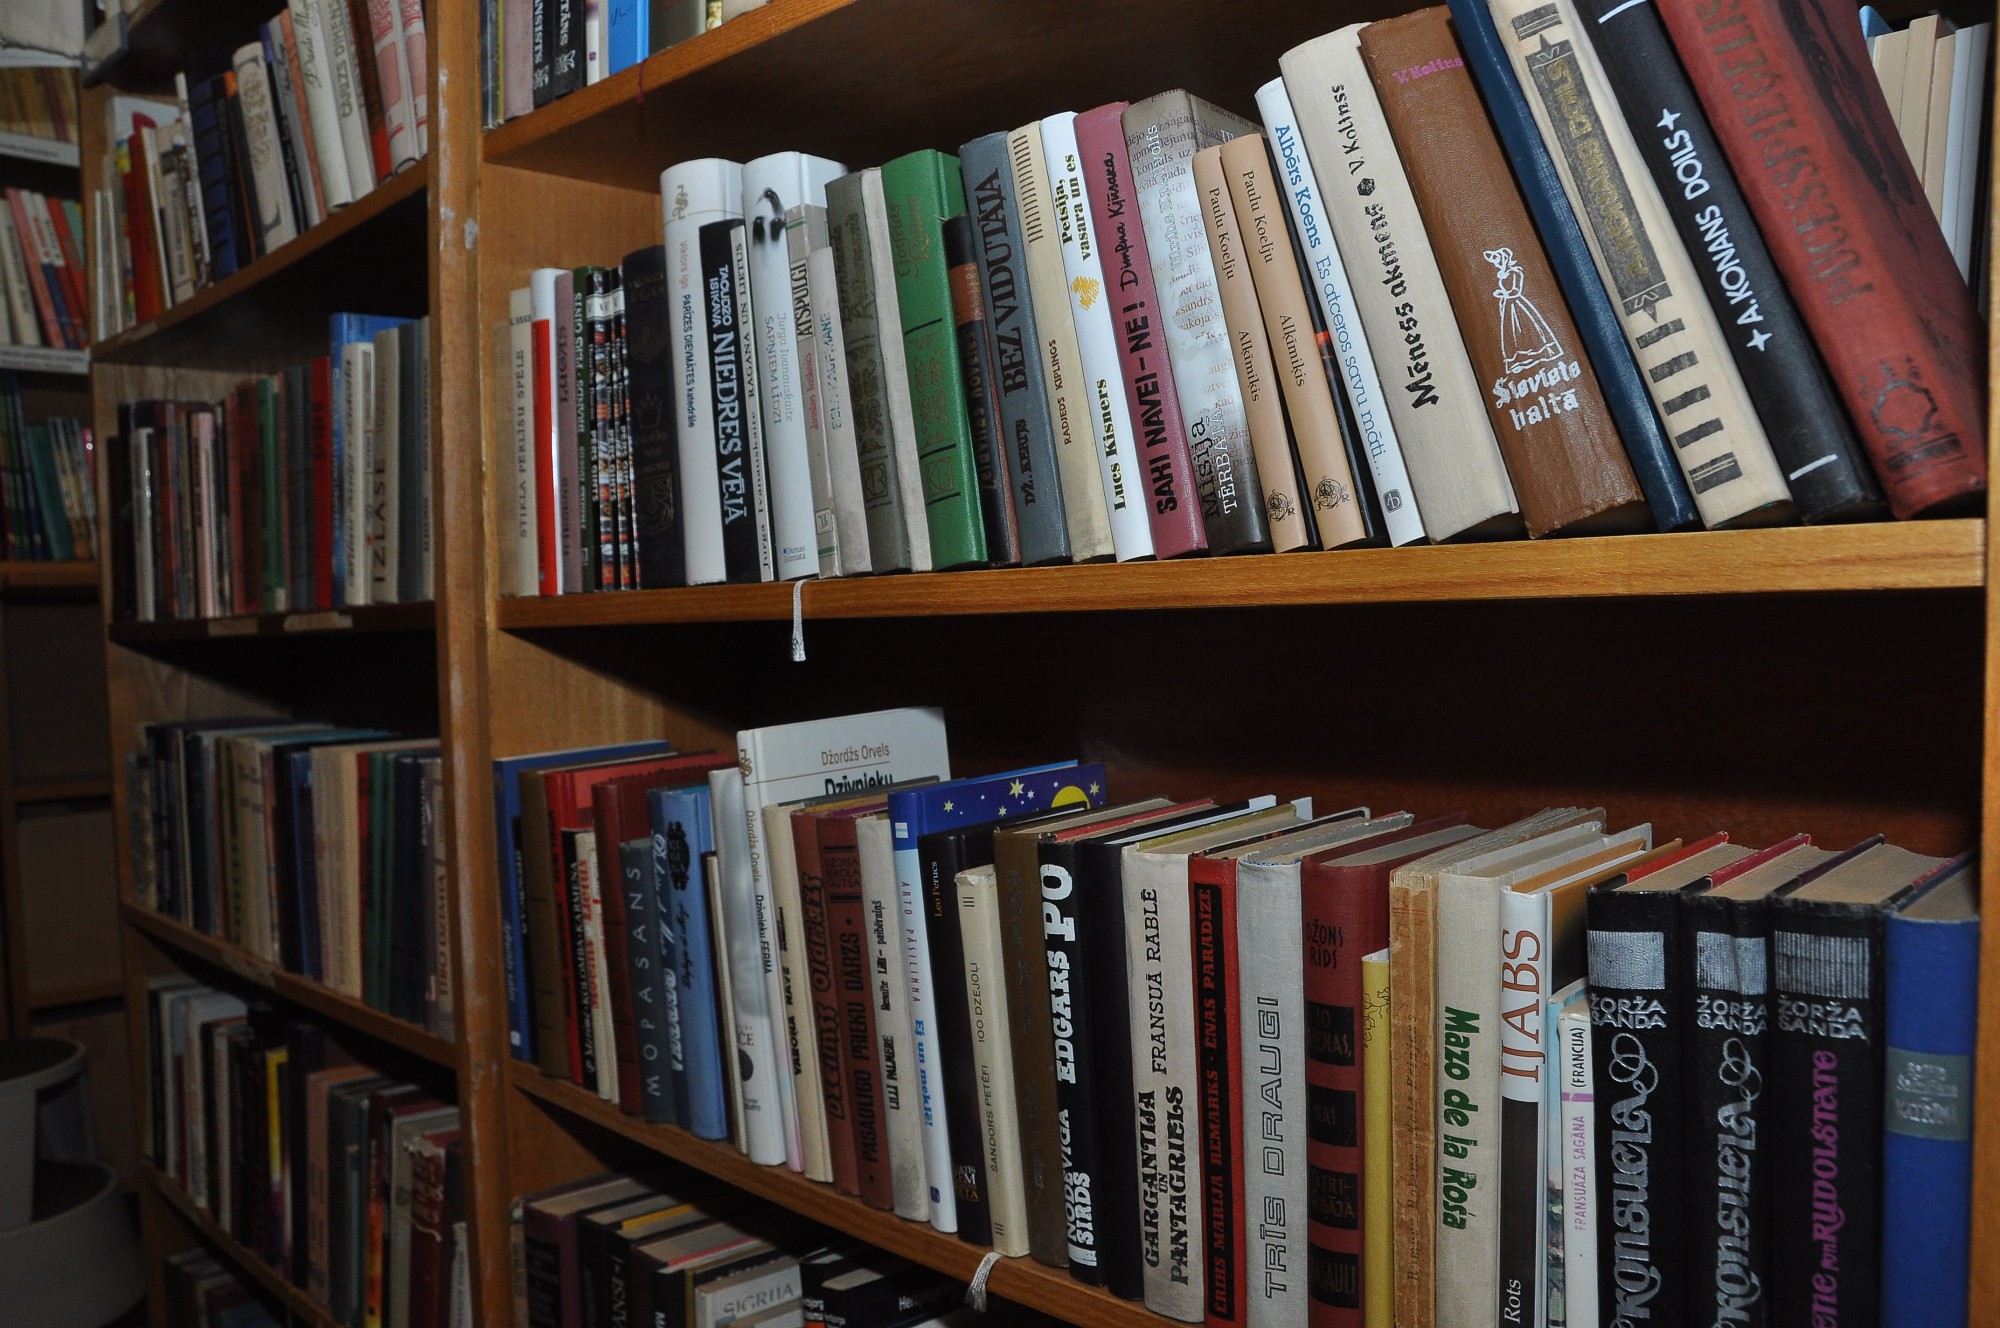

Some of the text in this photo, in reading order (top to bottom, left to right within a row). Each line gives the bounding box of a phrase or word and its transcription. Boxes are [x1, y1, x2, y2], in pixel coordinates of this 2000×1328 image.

[1275, 124, 1302, 187] Albērs
[1663, 128, 1711, 201] DOILS
[1063, 153, 1092, 262] vasara un es
[1209, 187, 1224, 229] Paulu
[1218, 232, 1236, 280] Koelju
[1243, 169, 1259, 212] Paulu
[1254, 215, 1274, 264] Koelju
[1294, 186, 1322, 249] Koens
[734, 243, 747, 296] LIETUS
[1316, 255, 1332, 280] Es
[738, 302, 750, 326] UN
[1323, 282, 1352, 353] atceros
[742, 332, 756, 398] RAGANA
[996, 326, 1029, 398] BEZ
[1345, 356, 1367, 408] savu
[1394, 302, 1440, 410] Mēness
[712, 331, 743, 455] NIEDRES
[770, 385, 783, 426] LĪDZI
[1048, 338, 1073, 446] RADJEDS KIPLINGS
[1096, 378, 1127, 513] Lucs Kisners
[860, 742, 891, 759] Orvels
[901, 880, 913, 918] ARTO
[931, 861, 943, 918] Leo Perucs
[1039, 863, 1077, 1085] EDGARS PO
[1140, 888, 1168, 1076] FRANSUĀ RABLĒ
[1591, 993, 1667, 1015] ŽORŽA
[847, 1001, 870, 1061] PRIEKU
[913, 1019, 925, 1039] Ej
[1591, 1012, 1668, 1030] SANDA
[1696, 994, 1768, 1019] ŽORŽA
[1696, 1014, 1768, 1036] SANDA
[1777, 994, 1864, 1024] ŽORŽA
[1777, 1015, 1868, 1041] SANDA
[917, 1042, 927, 1061] un
[1570, 1026, 1587, 1089] (FRANCIJA)
[1206, 1068, 1223, 1167] REMARKS
[1443, 1005, 1480, 1170] Mazo de la
[1138, 1090, 1160, 1269] GARGANTIJA
[1257, 996, 1287, 1300] TRĪS DRAUGI
[1073, 1171, 1095, 1246] SIRDS
[1158, 1173, 1169, 1194] UN
[1165, 1085, 1189, 1287] PANTAGRIELS
[1209, 1173, 1226, 1251] MARIJA
[1503, 1278, 1522, 1325] Rots
